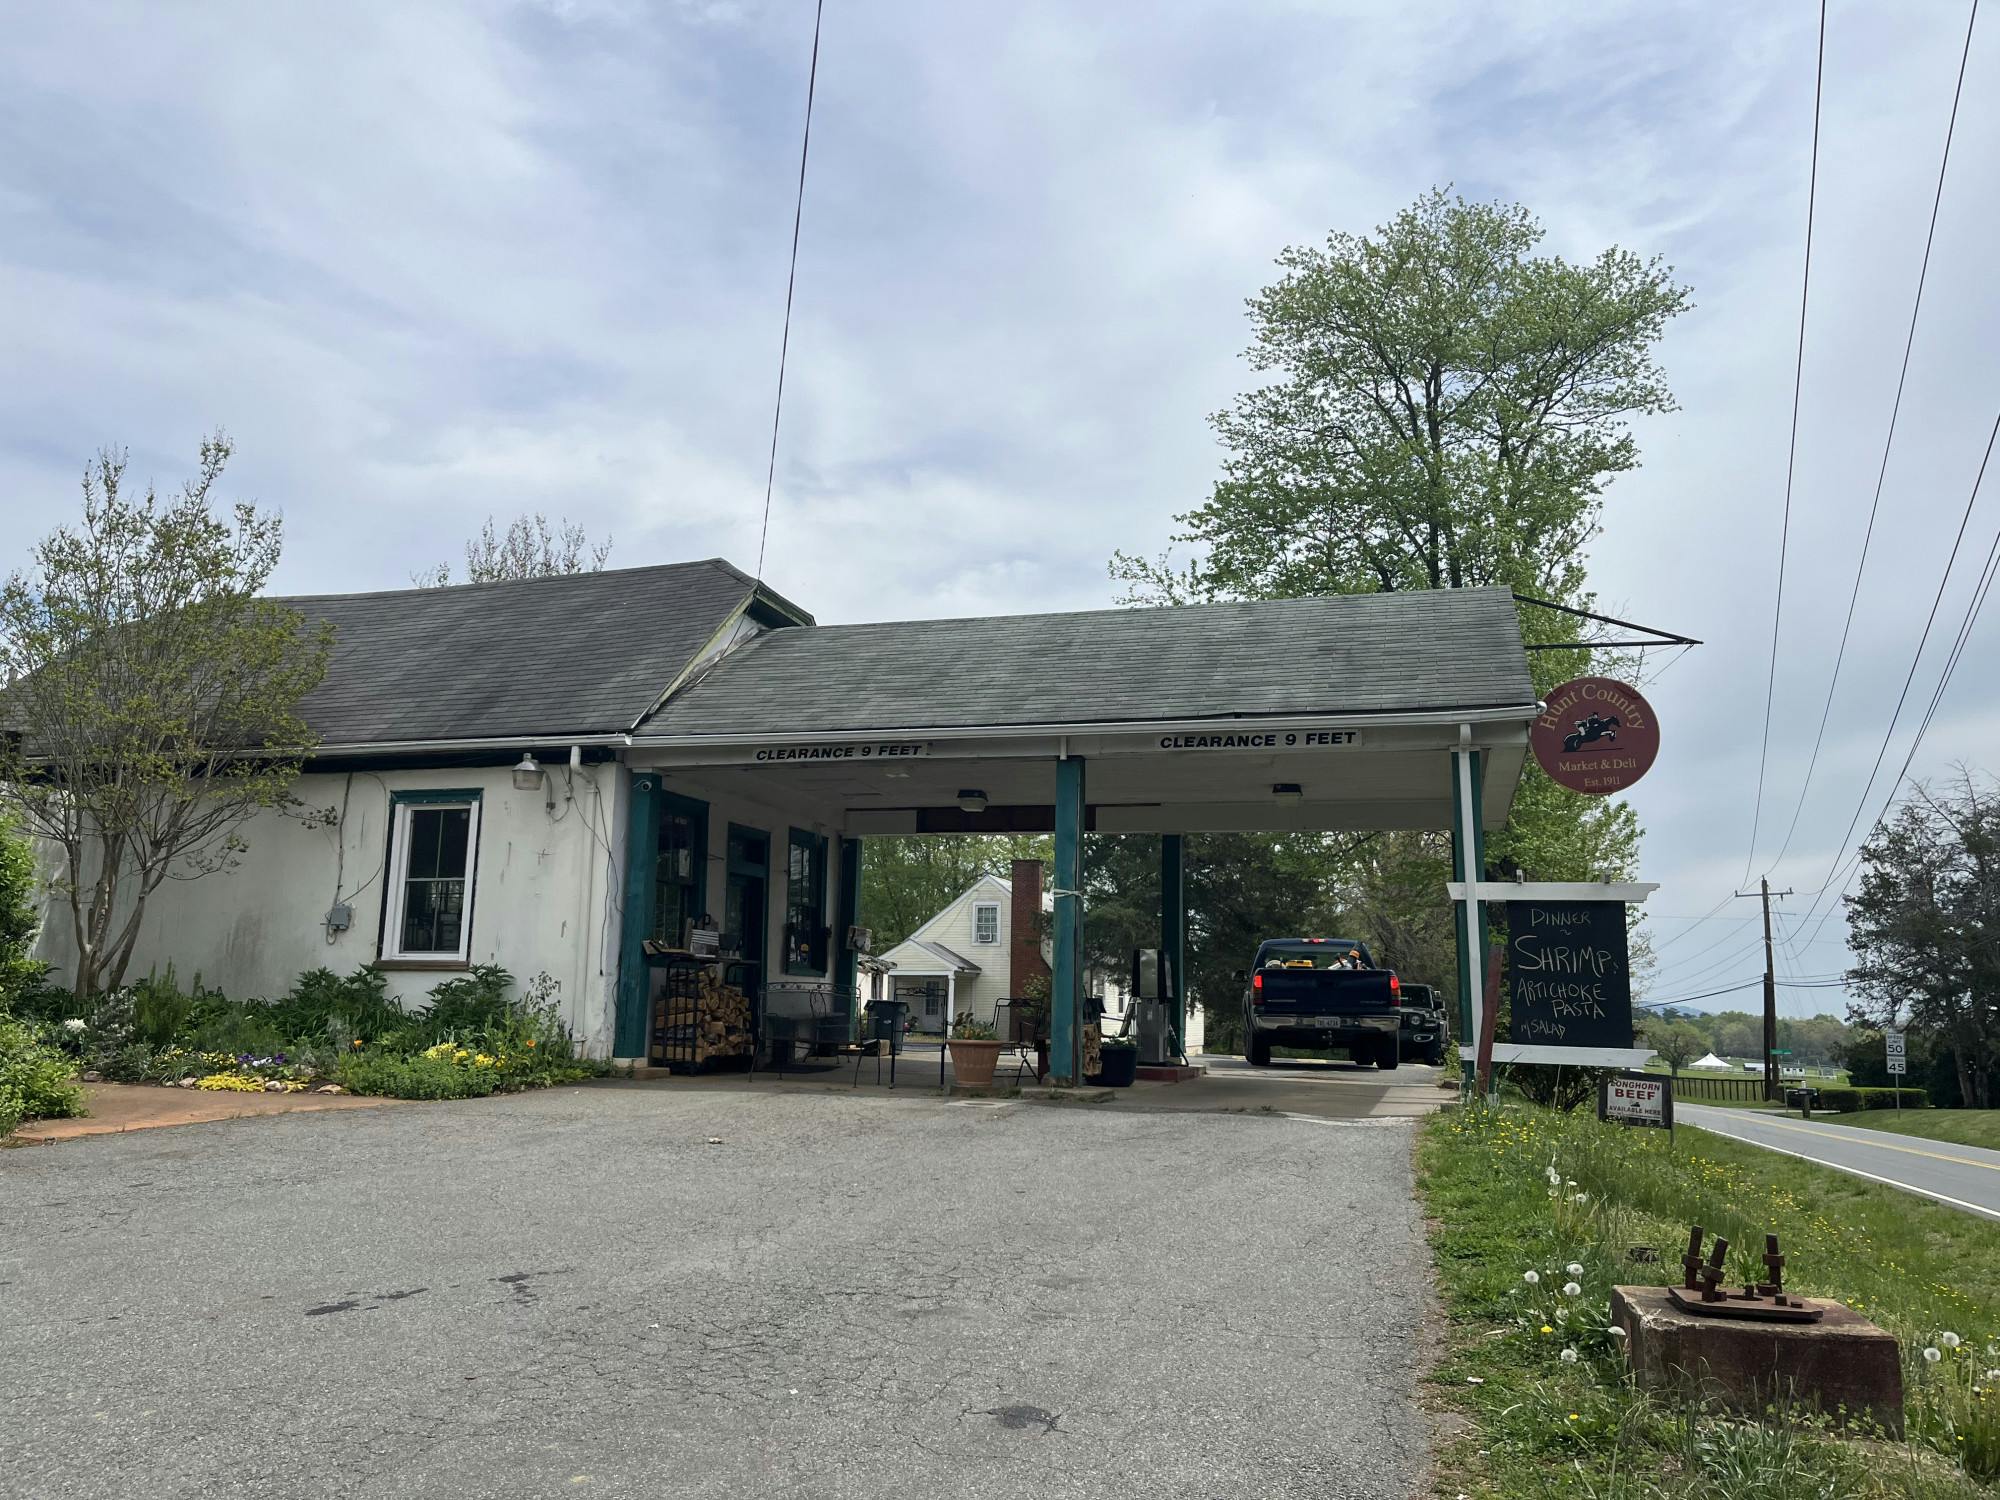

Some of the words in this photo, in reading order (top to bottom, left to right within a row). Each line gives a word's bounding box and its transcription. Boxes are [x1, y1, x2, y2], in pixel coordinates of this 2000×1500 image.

[1540, 690, 1581, 730] Hunt
[1581, 684, 1645, 729] Country
[1160, 734, 1276, 748] CLEARANCE
[1285, 733, 1297, 746] 9
[1306, 732, 1357, 745] FEET
[756, 746, 853, 761] CLEARANCE
[861, 746, 872, 757] 9
[878, 745, 922, 756] FEET
[1559, 760, 1598, 772] Market
[1600, 759, 1611, 769] &
[1613, 758, 1637, 769] Deli
[1603, 776, 1621, 787] 1911
[1530, 908, 1591, 927] DINNER
[1517, 977, 1607, 1007] ARTICHOKE
[1552, 999, 1606, 1019] PASTA
[1888, 1045, 1903, 1053] 50
[1889, 1063, 1905, 1071] 45
[1615, 1088, 1656, 1100] BEEF
[1608, 1105, 1643, 1114] AVAILABLE
